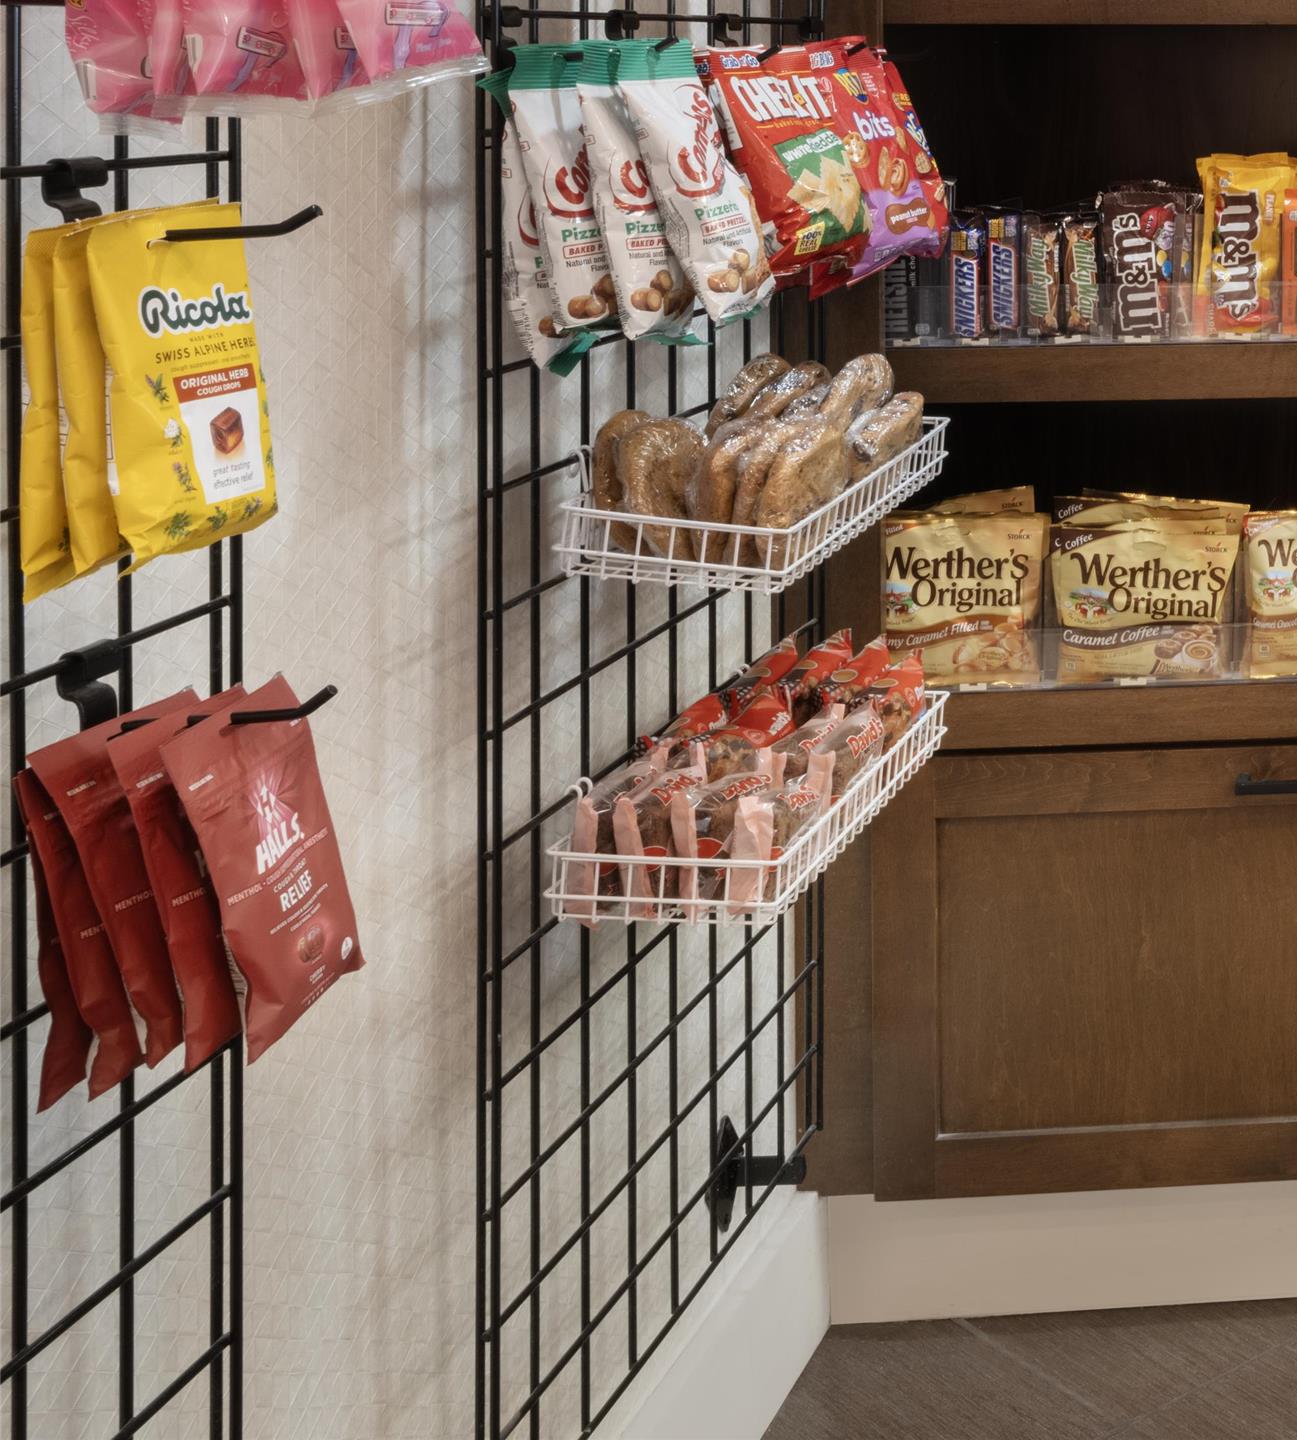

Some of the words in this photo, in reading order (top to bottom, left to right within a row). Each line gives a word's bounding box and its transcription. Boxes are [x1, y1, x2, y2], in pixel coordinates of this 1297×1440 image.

[853, 111, 895, 141] bits
[569, 244, 595, 255] BAKED
[630, 239, 654, 249] BAKED
[954, 257, 977, 336] SNICKERS
[991, 244, 1014, 328] SNICKERS
[141, 286, 250, 334] Ricola
[155, 347, 191, 364] SWISS
[194, 340, 228, 357] ALPINE
[181, 373, 228, 390] ORIGINAL
[229, 367, 249, 379] HERB
[197, 385, 222, 396] COUGH
[1058, 503, 1083, 519] Coffee
[1065, 533, 1093, 551] Coffee
[885, 546, 1029, 580] Werther's
[1070, 552, 1227, 592] Werther's
[911, 578, 1022, 613] Original
[1107, 586, 1218, 620] Original
[906, 629, 949, 646] Caramel
[950, 621, 979, 635] Filled
[1063, 629, 1117, 646] Caramel
[1120, 625, 1160, 643] Coffee
[227, 882, 264, 907] MENTHOL
[280, 870, 313, 912] RELIEF
